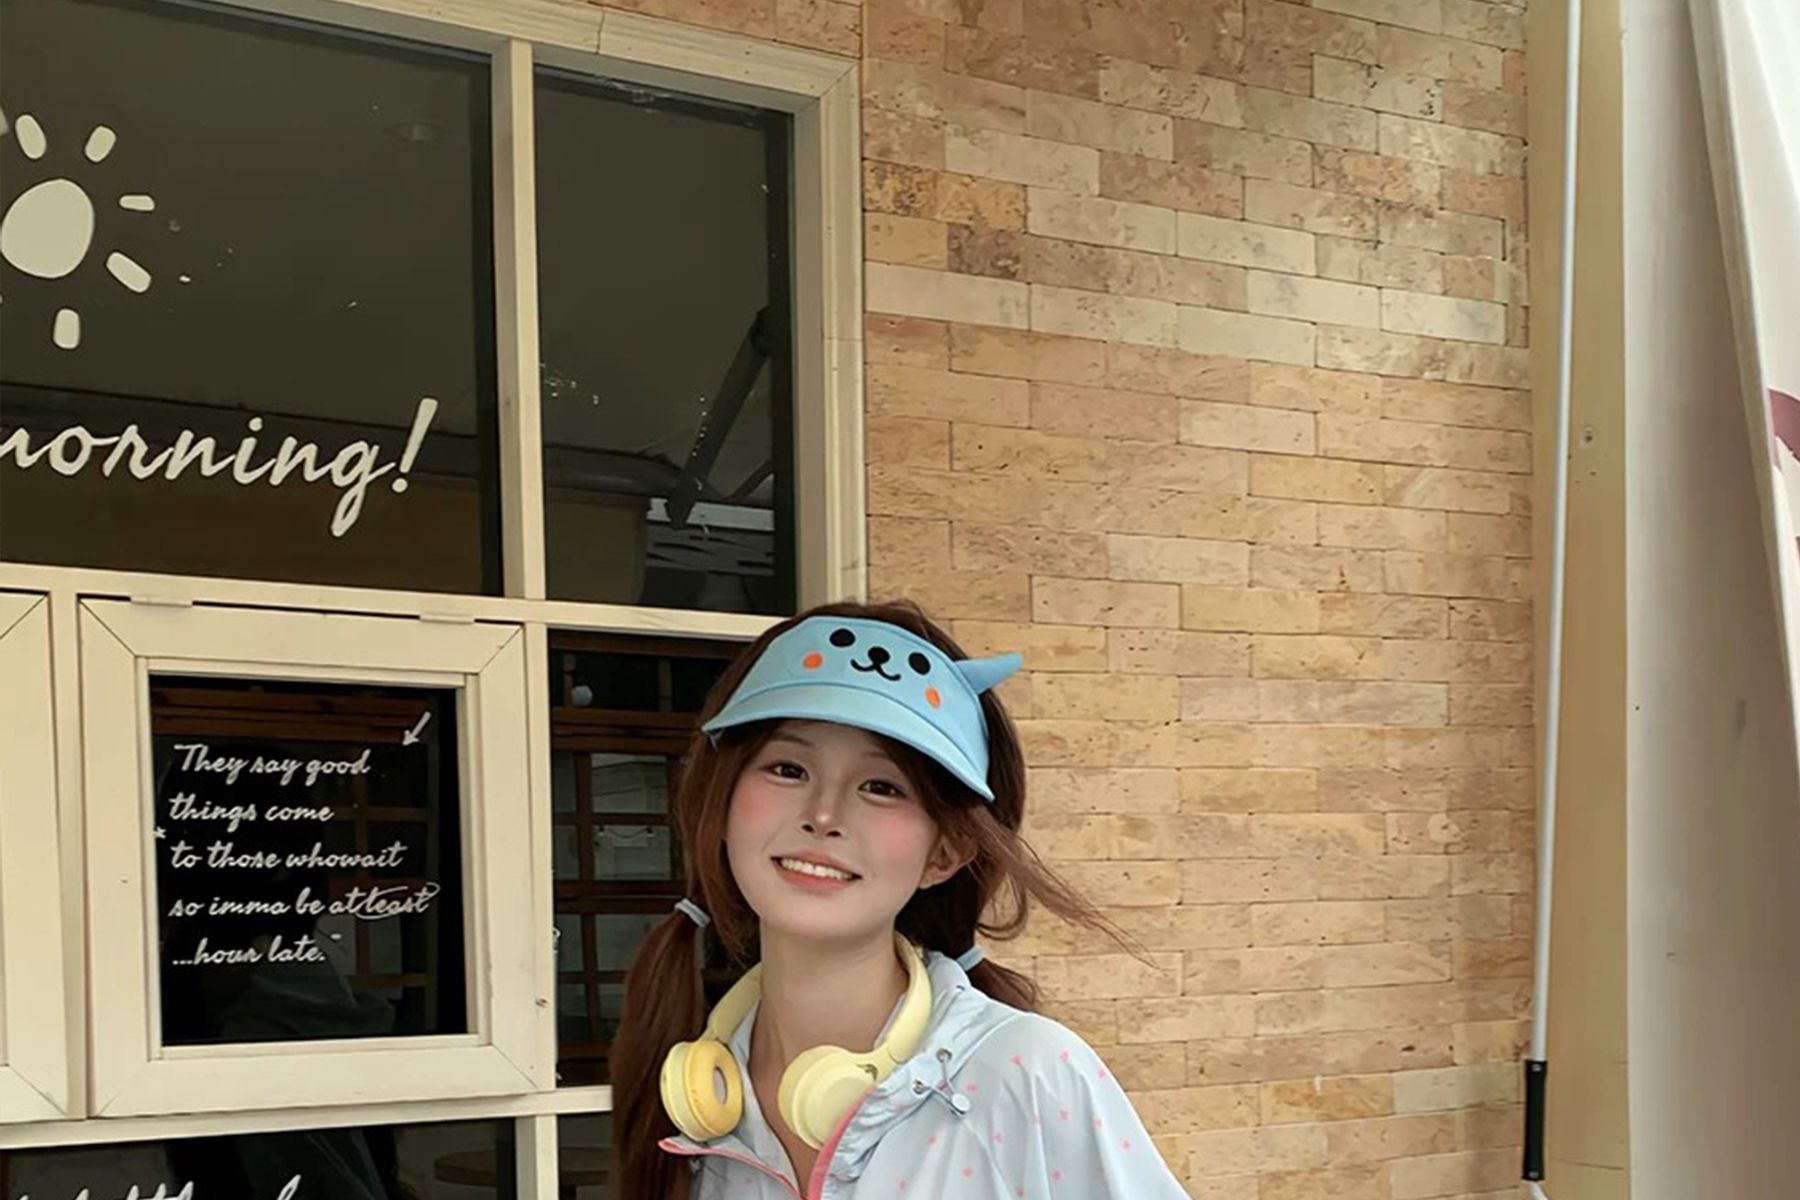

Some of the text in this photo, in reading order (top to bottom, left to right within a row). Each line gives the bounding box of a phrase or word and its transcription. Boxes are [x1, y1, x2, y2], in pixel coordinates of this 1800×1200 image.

[249, 755, 303, 787] say
[305, 748, 371, 787] good
[168, 791, 335, 833] things come
[169, 839, 203, 869] to
[206, 839, 282, 869] those
[167, 899, 205, 917] so
[208, 896, 291, 916] imma
[295, 886, 325, 915] be
